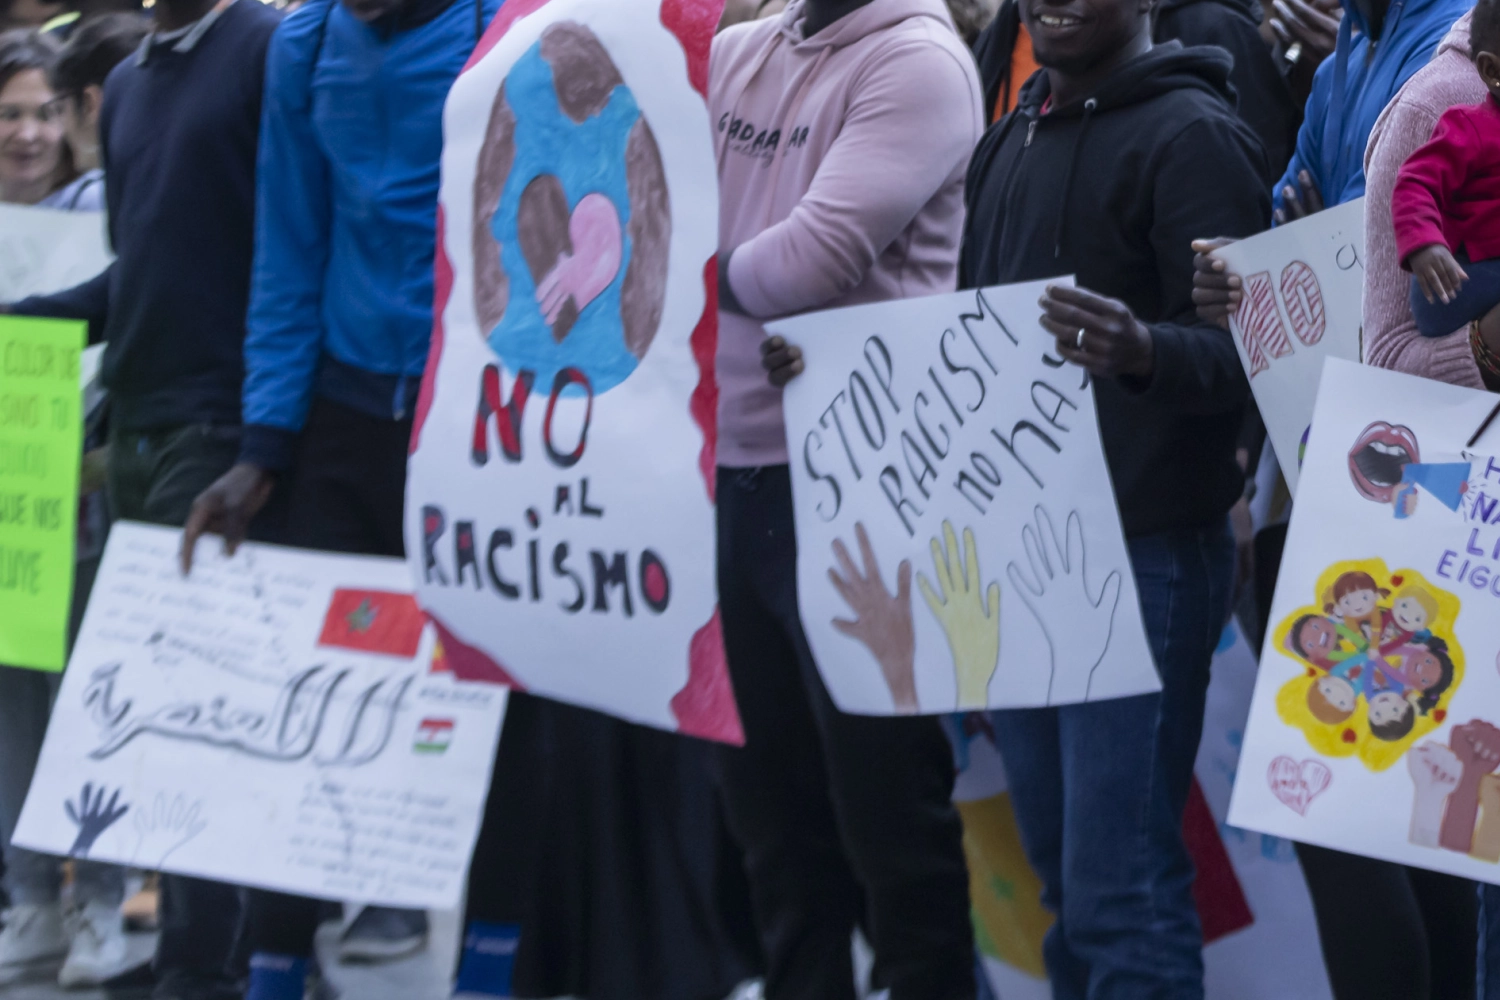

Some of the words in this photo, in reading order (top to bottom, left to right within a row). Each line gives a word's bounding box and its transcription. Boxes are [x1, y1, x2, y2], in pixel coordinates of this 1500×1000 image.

[1233, 260, 1327, 379] NO
[469, 363, 594, 470] NO
[804, 335, 901, 523] STOP
[877, 287, 1019, 538] RACISM
[553, 477, 605, 519] AL
[420, 503, 672, 619] RACiSMO
